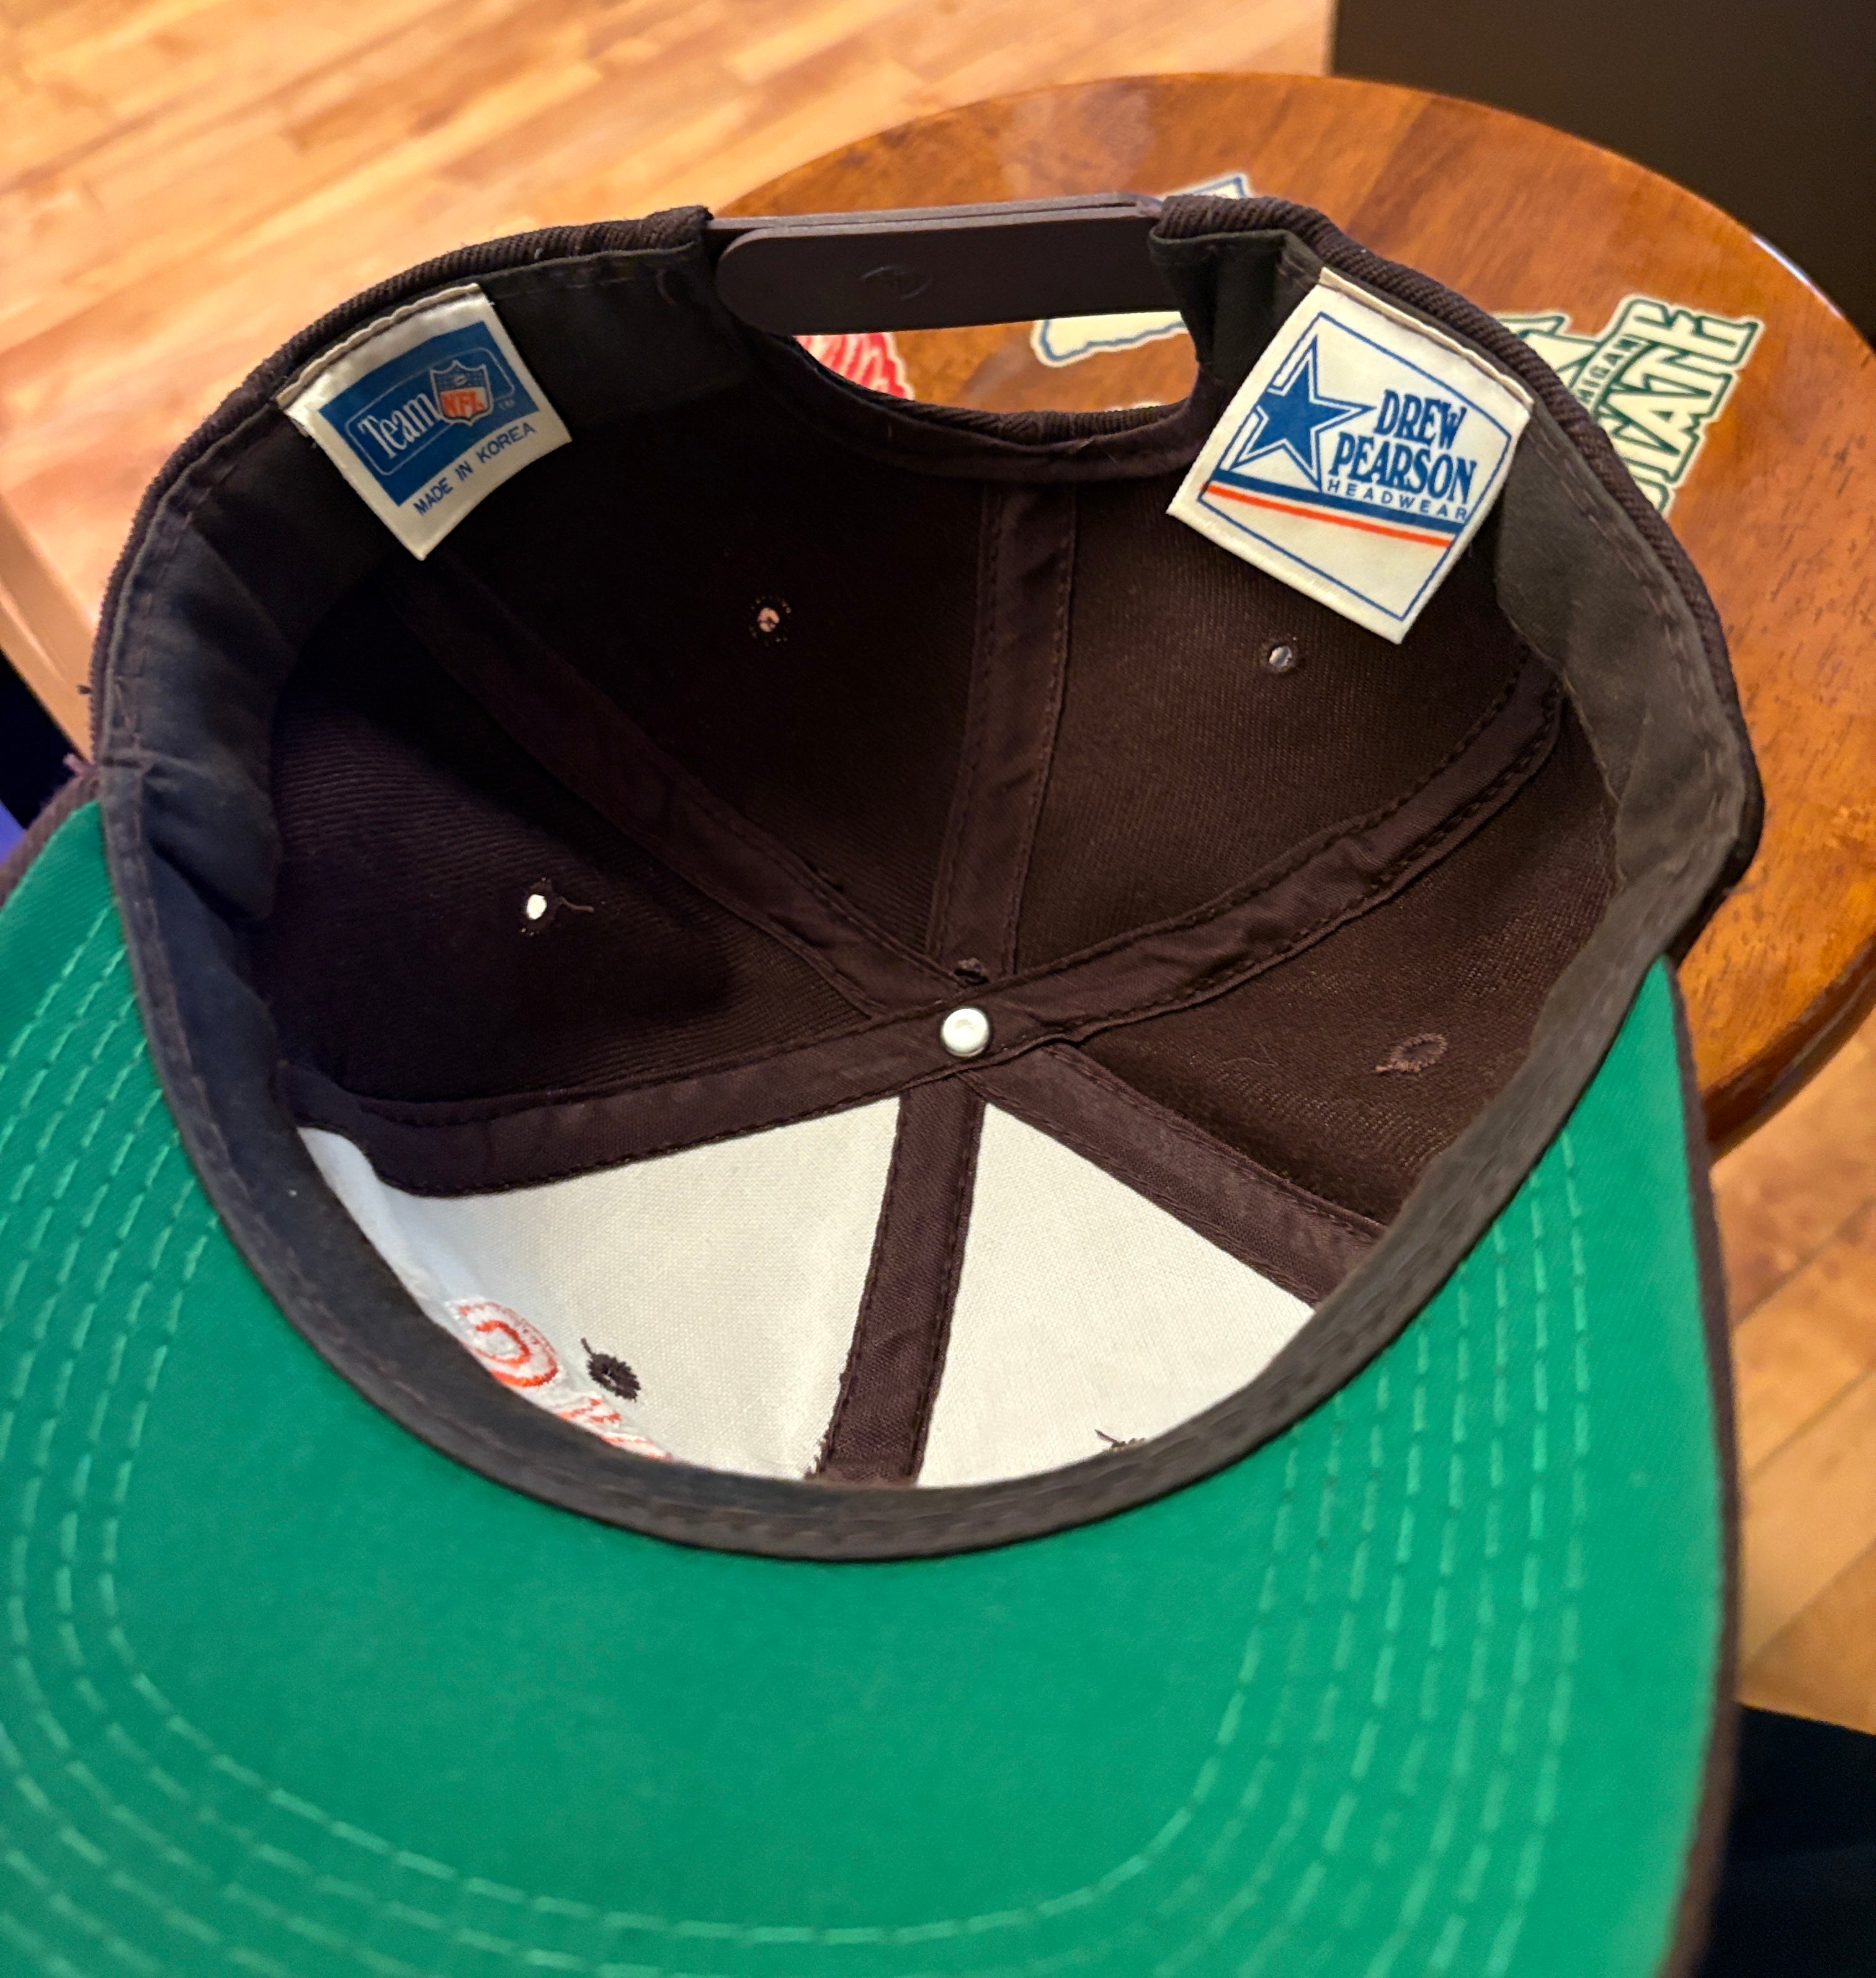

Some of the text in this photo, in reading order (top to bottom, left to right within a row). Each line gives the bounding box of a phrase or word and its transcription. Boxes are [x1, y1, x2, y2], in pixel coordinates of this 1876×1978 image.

[1577, 338, 1640, 404] HIGAN
[1599, 299, 1759, 513] TATE
[357, 392, 441, 460] Team
[440, 390, 486, 417] NFL
[1373, 388, 1467, 450] DREW
[413, 422, 536, 515] MADE IN KOREA
[1328, 432, 1477, 504] PEARSON
[1328, 478, 1468, 520] HEADWEAR
